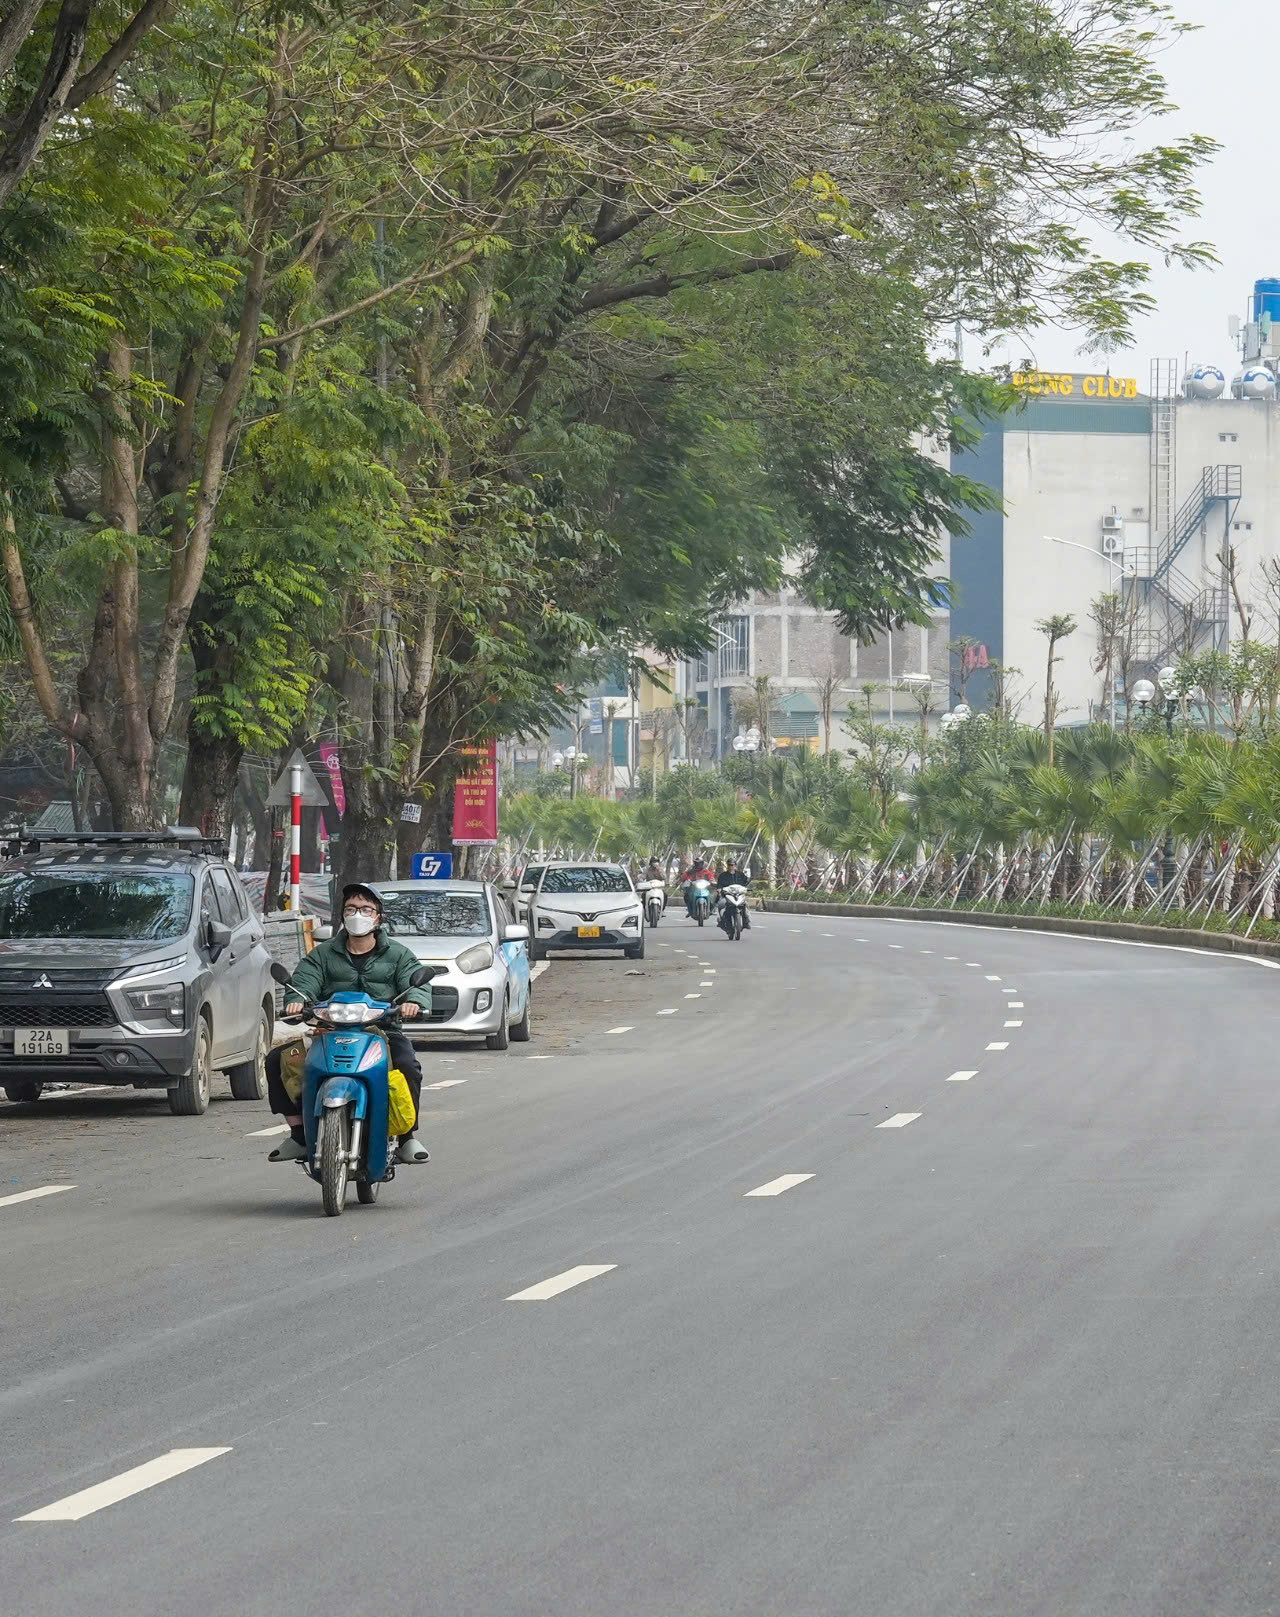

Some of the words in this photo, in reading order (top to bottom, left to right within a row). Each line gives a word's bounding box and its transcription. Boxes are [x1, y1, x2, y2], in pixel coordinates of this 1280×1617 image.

[1082, 375, 1137, 398] CLUB
[420, 856, 441, 877] G7
[30, 1030, 53, 1042] 22A
[21, 1042, 63, 1054] 191.69
